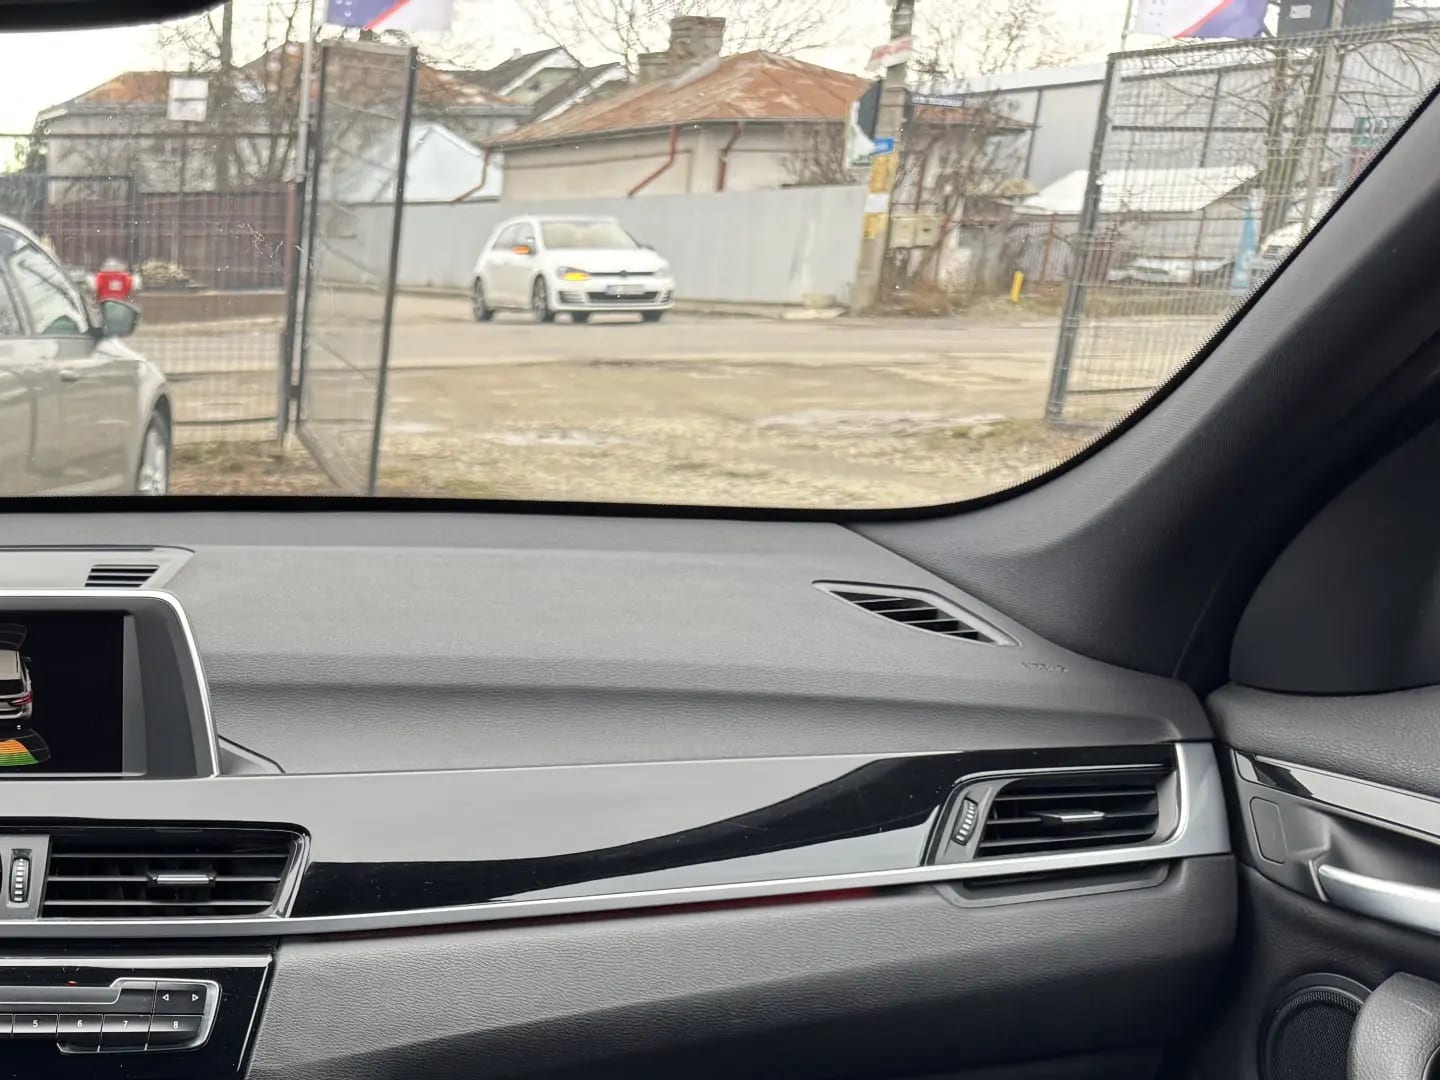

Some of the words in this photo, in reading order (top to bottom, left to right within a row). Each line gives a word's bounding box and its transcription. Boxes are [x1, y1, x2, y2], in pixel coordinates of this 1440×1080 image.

[32, 1020, 38, 1028] 5
[77, 1020, 83, 1028] 6
[122, 1020, 128, 1028] 7
[173, 1020, 179, 1029] 8
